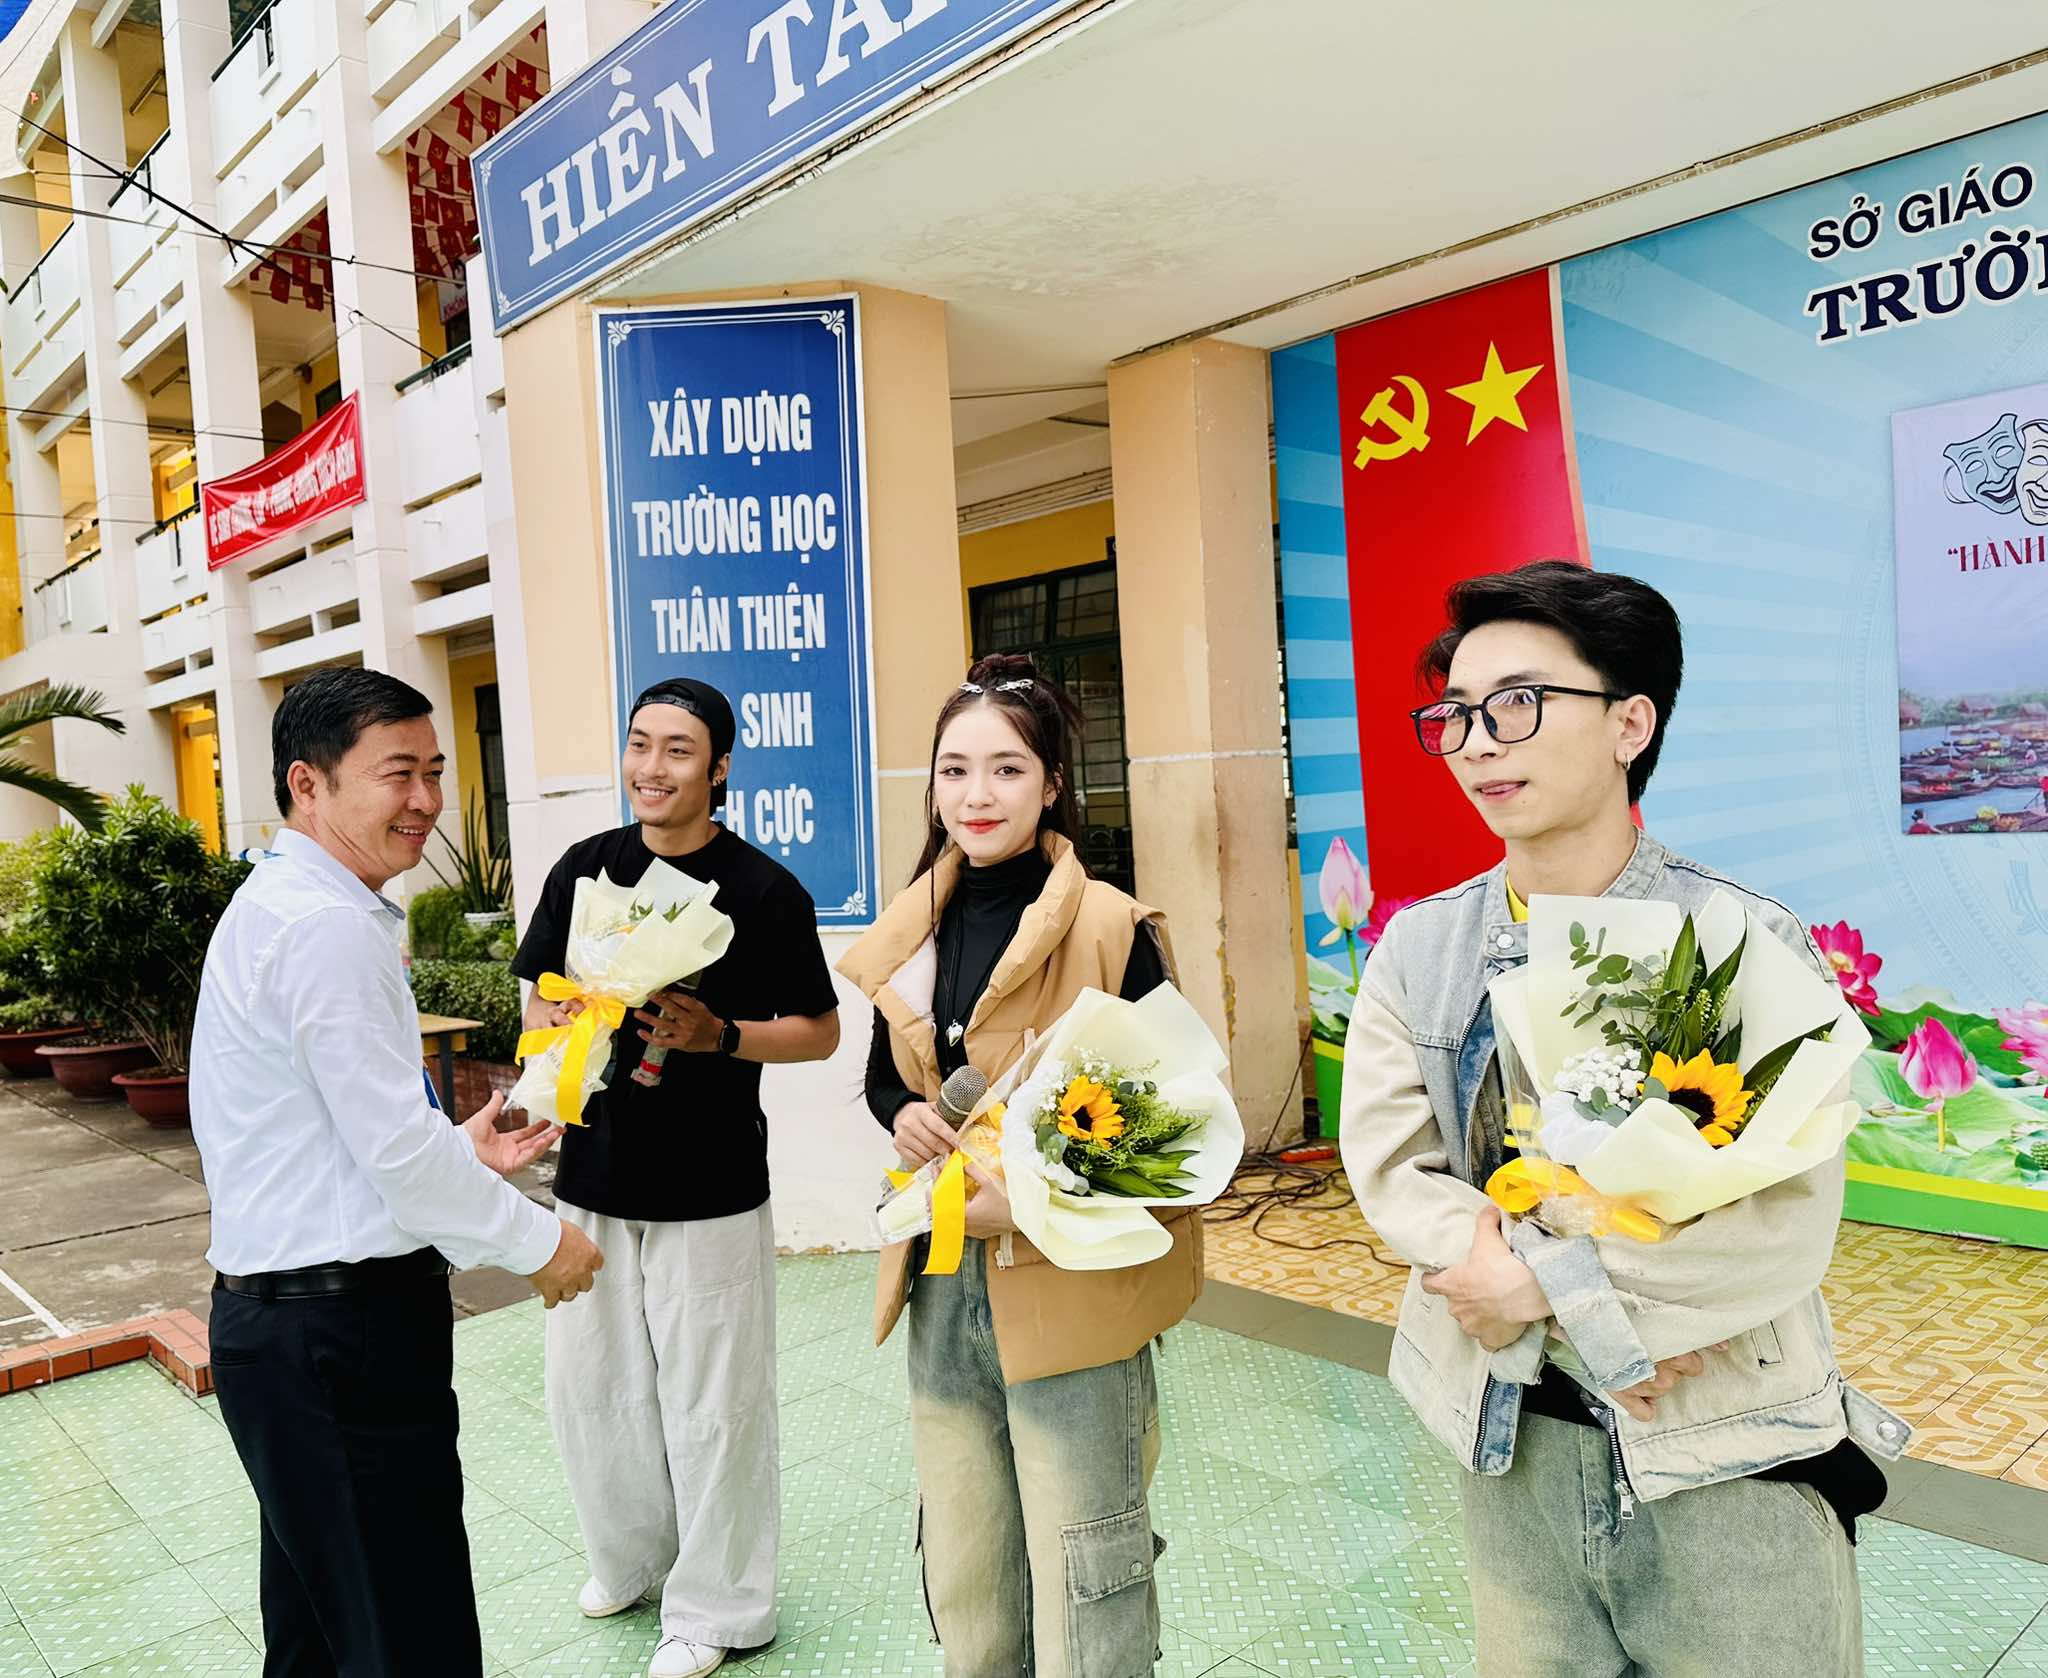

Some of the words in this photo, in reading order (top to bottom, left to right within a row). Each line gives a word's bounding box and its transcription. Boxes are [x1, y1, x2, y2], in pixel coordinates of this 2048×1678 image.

[521, 58, 716, 268] HIỀN
[1809, 195, 1881, 260] SỞ
[1898, 165, 2034, 234] GIÁO
[1806, 229, 2048, 342] TRƯỜ
[647, 386, 712, 458] XÂY
[721, 389, 813, 467] DỰNG
[631, 484, 762, 557] TRƯỜNG
[769, 492, 837, 564] HỌC
[650, 584, 732, 655] THÂN
[737, 581, 827, 663] THIỆN
[740, 691, 814, 749] SINH
[753, 782, 815, 857] CỰC
